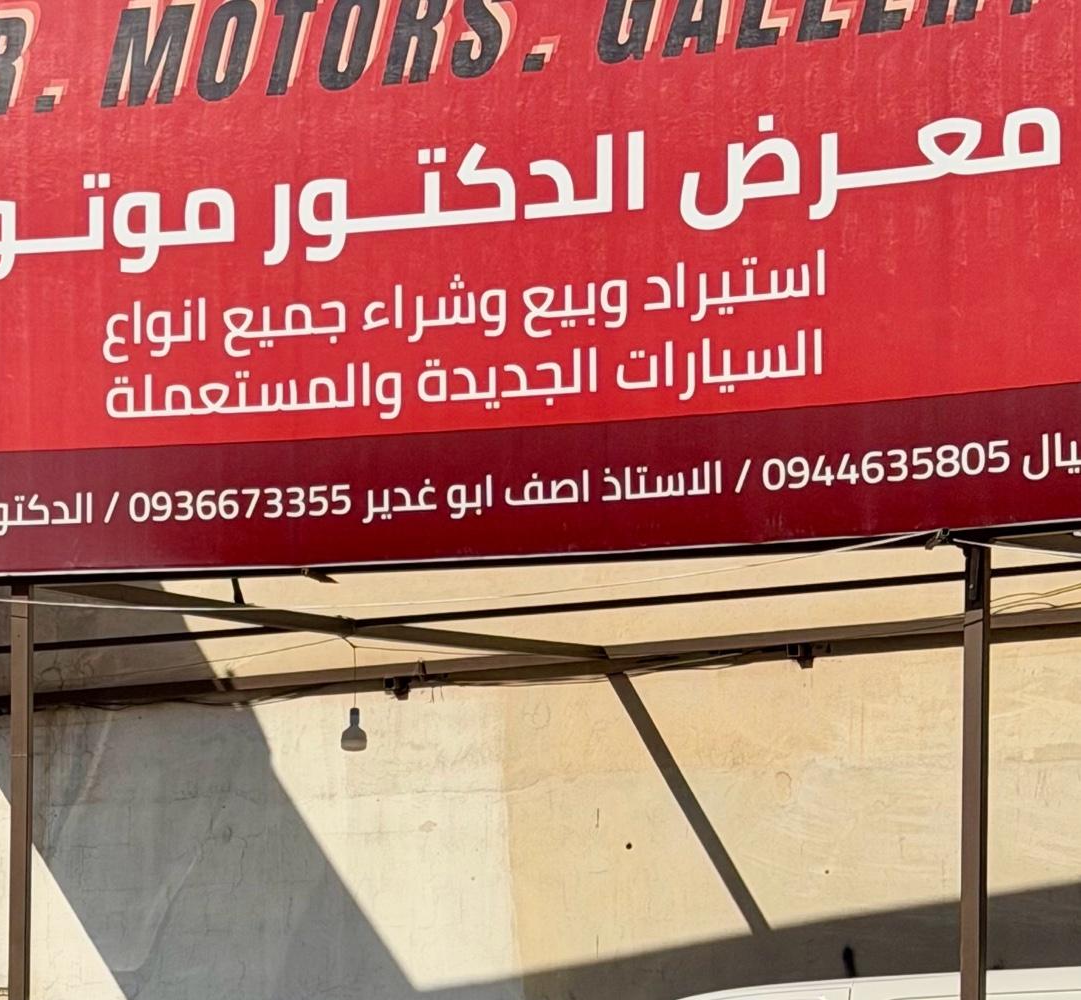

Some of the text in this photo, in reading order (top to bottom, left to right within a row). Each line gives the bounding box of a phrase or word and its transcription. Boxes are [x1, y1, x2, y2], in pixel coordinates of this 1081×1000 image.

[680, 107, 1061, 231] معرض
[264, 131, 645, 266] الدكتور
[102, 248, 826, 364] استيراد وبيع وشراء جميع انواع
[105, 328, 822, 420] السيارات الجديدة والمستعملة
[762, 439, 1010, 492] 0944635805
[1022, 431, 1081, 480] يال
[129, 484, 352, 522] 0936673355
[363, 478, 437, 524] غدير
[446, 474, 493, 520] ابو
[504, 469, 589, 506] اصف
[602, 460, 722, 501] الاستاذ
